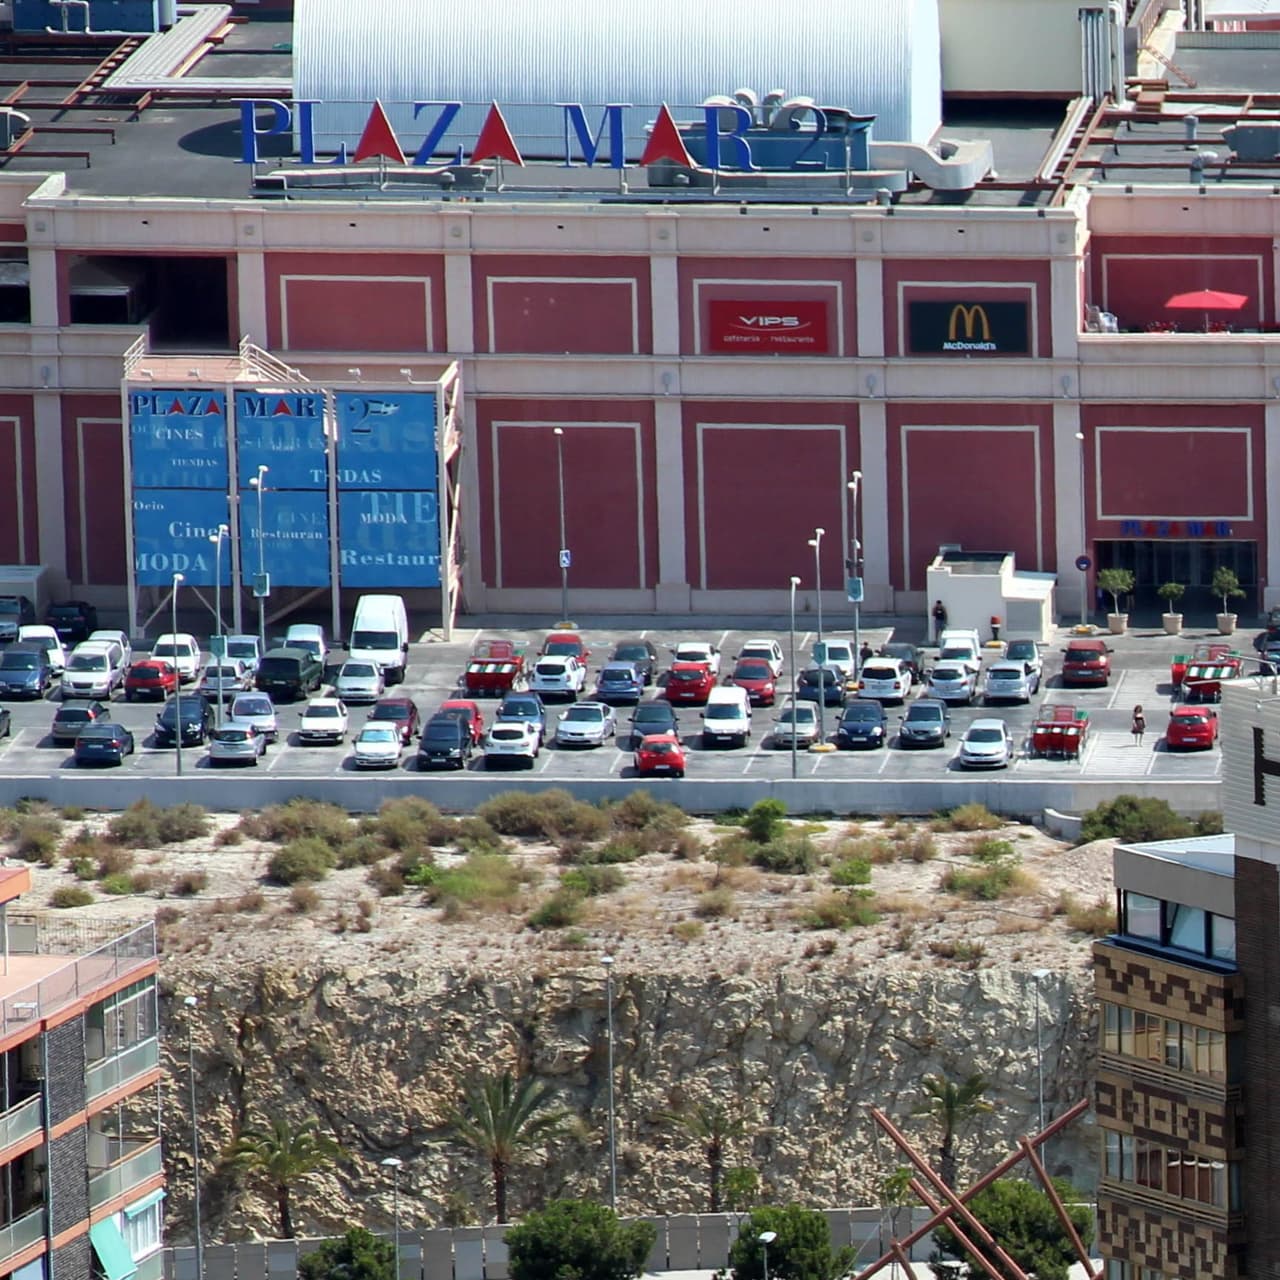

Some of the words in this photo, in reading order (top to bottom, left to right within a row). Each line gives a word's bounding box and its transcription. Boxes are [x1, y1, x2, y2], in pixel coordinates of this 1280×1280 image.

[231, 97, 525, 168] PLAZA
[543, 101, 761, 171] MAR
[790, 103, 829, 170] 2
[739, 316, 799, 326] VIPS
[943, 341, 997, 351] McDonald's
[132, 395, 221, 416] PLAZA
[244, 397, 319, 418] MAR
[155, 427, 204, 440] CINES
